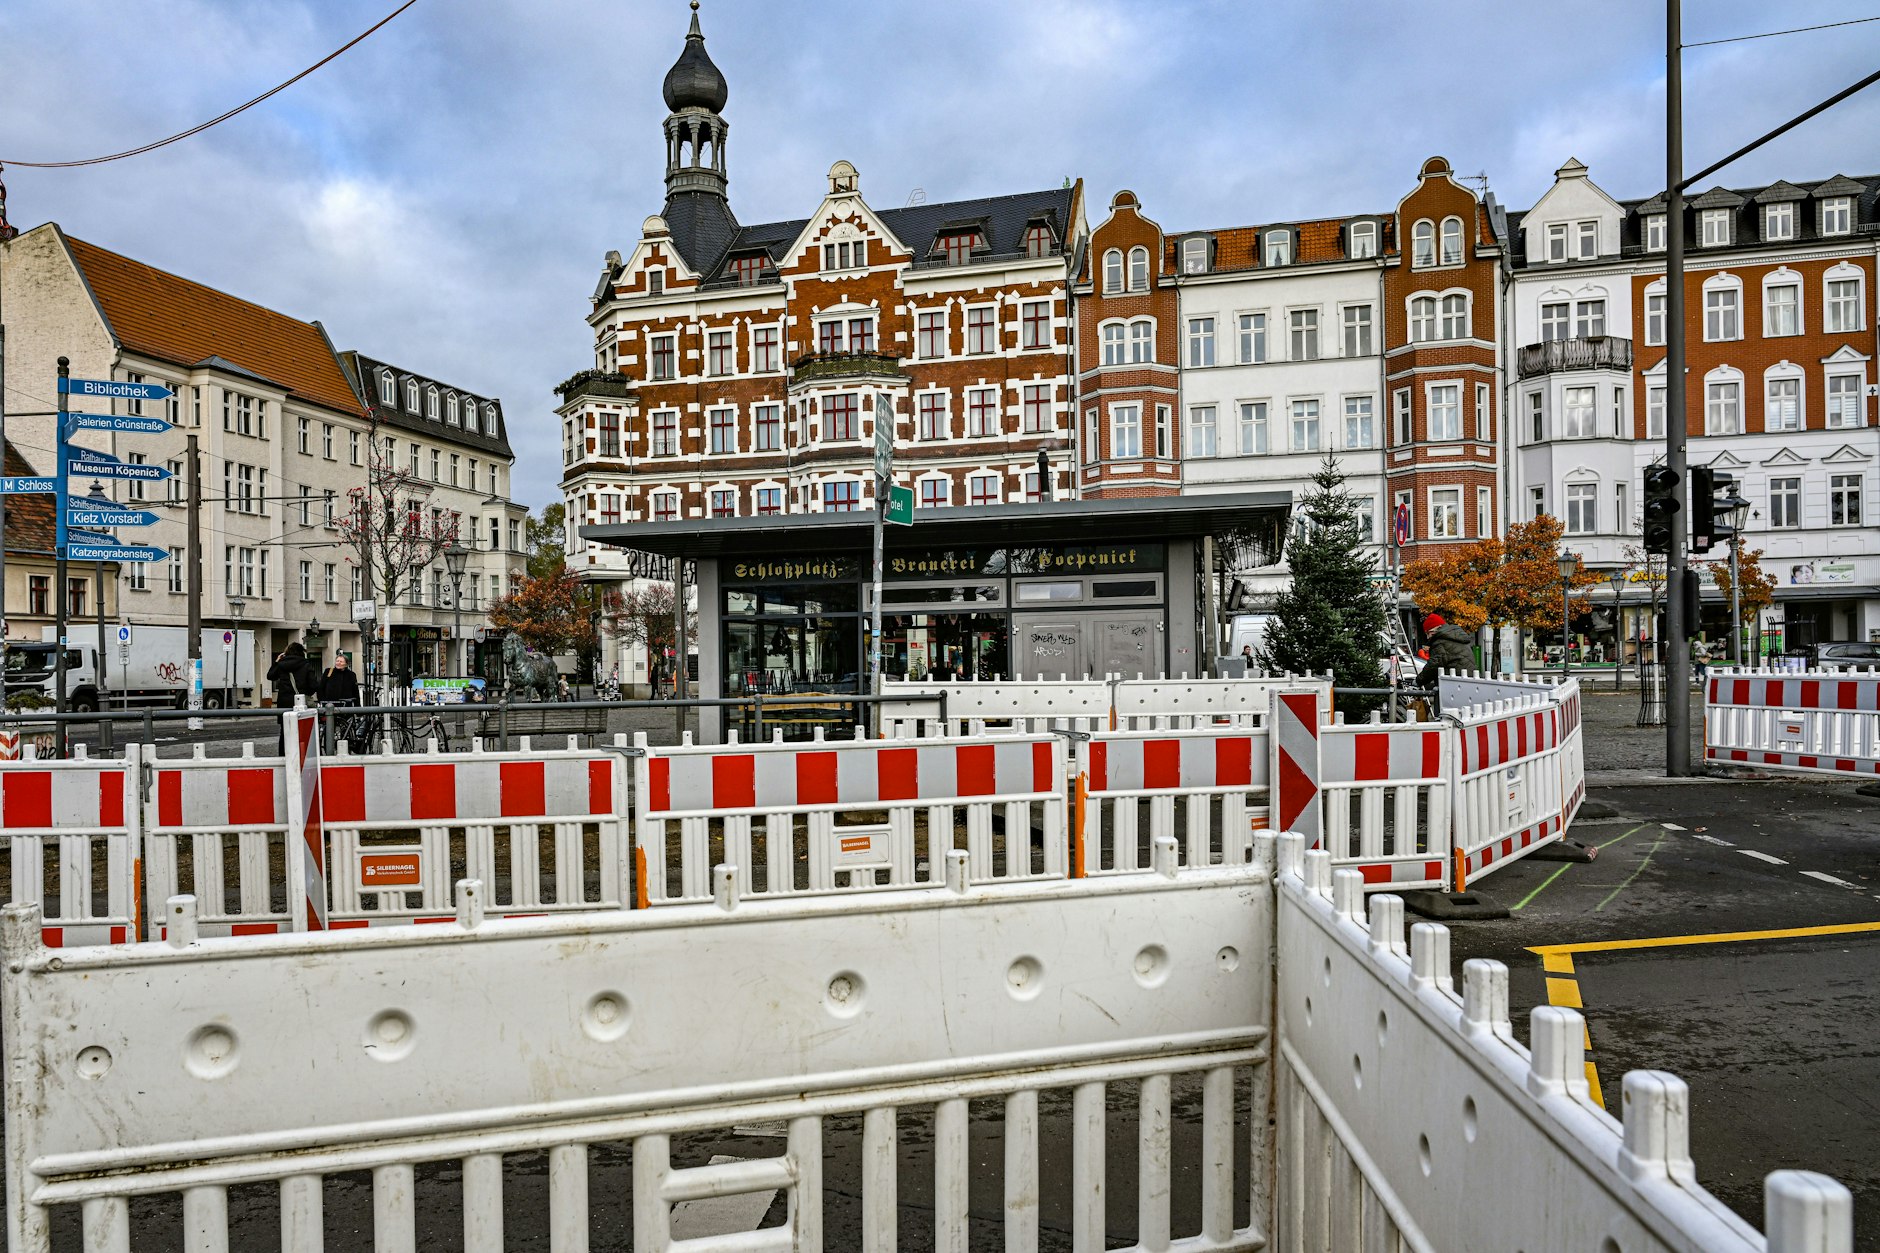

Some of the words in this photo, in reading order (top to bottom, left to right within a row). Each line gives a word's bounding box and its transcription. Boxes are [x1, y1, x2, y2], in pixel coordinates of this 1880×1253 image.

[84, 382, 149, 397] Bibliothek
[114, 418, 163, 431] Grünstraße
[73, 463, 113, 474] Museum
[116, 465, 160, 478] Köpenick
[18, 480, 53, 491] Schloss
[74, 513, 98, 523] Kietz
[101, 513, 142, 524] Vorstadt
[72, 547, 154, 560] Katzengrabensteg
[892, 556, 975, 572] Brauerei
[417, 628, 437, 640] Bistro
[424, 679, 446, 688] DEIN
